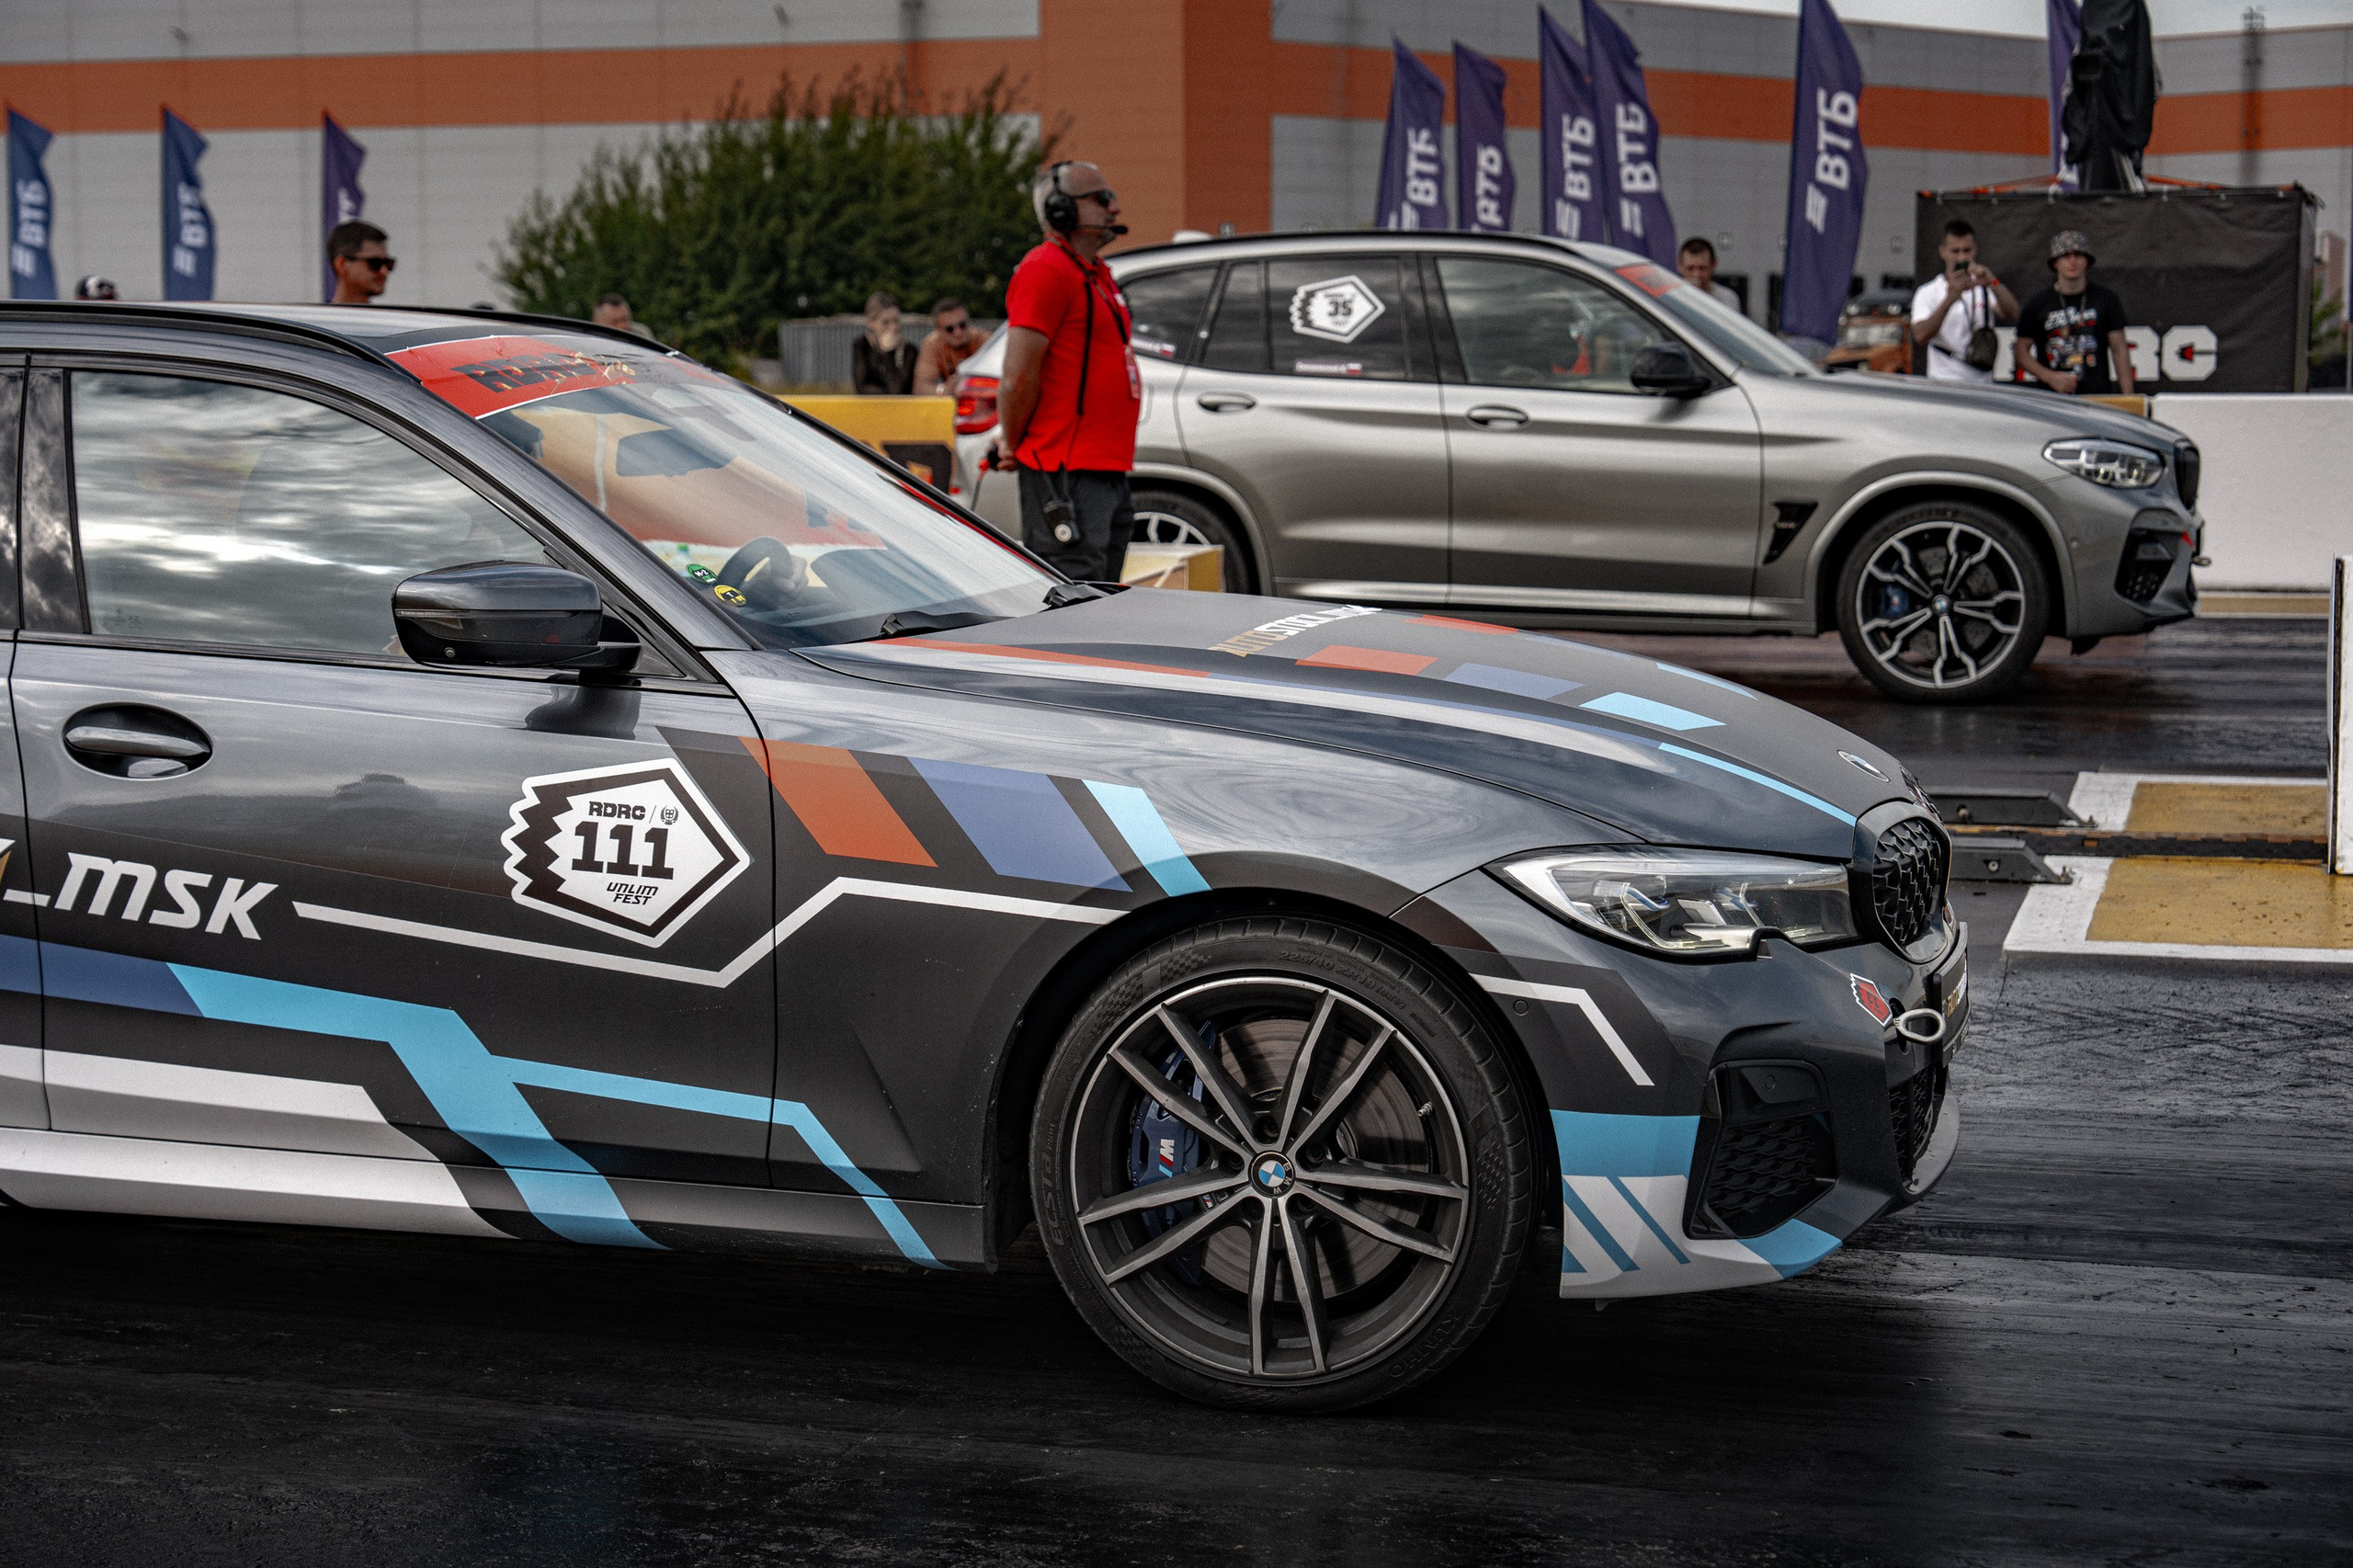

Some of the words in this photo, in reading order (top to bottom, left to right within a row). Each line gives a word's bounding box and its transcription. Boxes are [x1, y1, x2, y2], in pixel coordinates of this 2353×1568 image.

[1815, 86, 1859, 191] ВТБ
[588, 801, 646, 821] RDRC
[572, 821, 674, 880] 111
[607, 882, 659, 896] UNLIM
[612, 893, 653, 905] FEST
